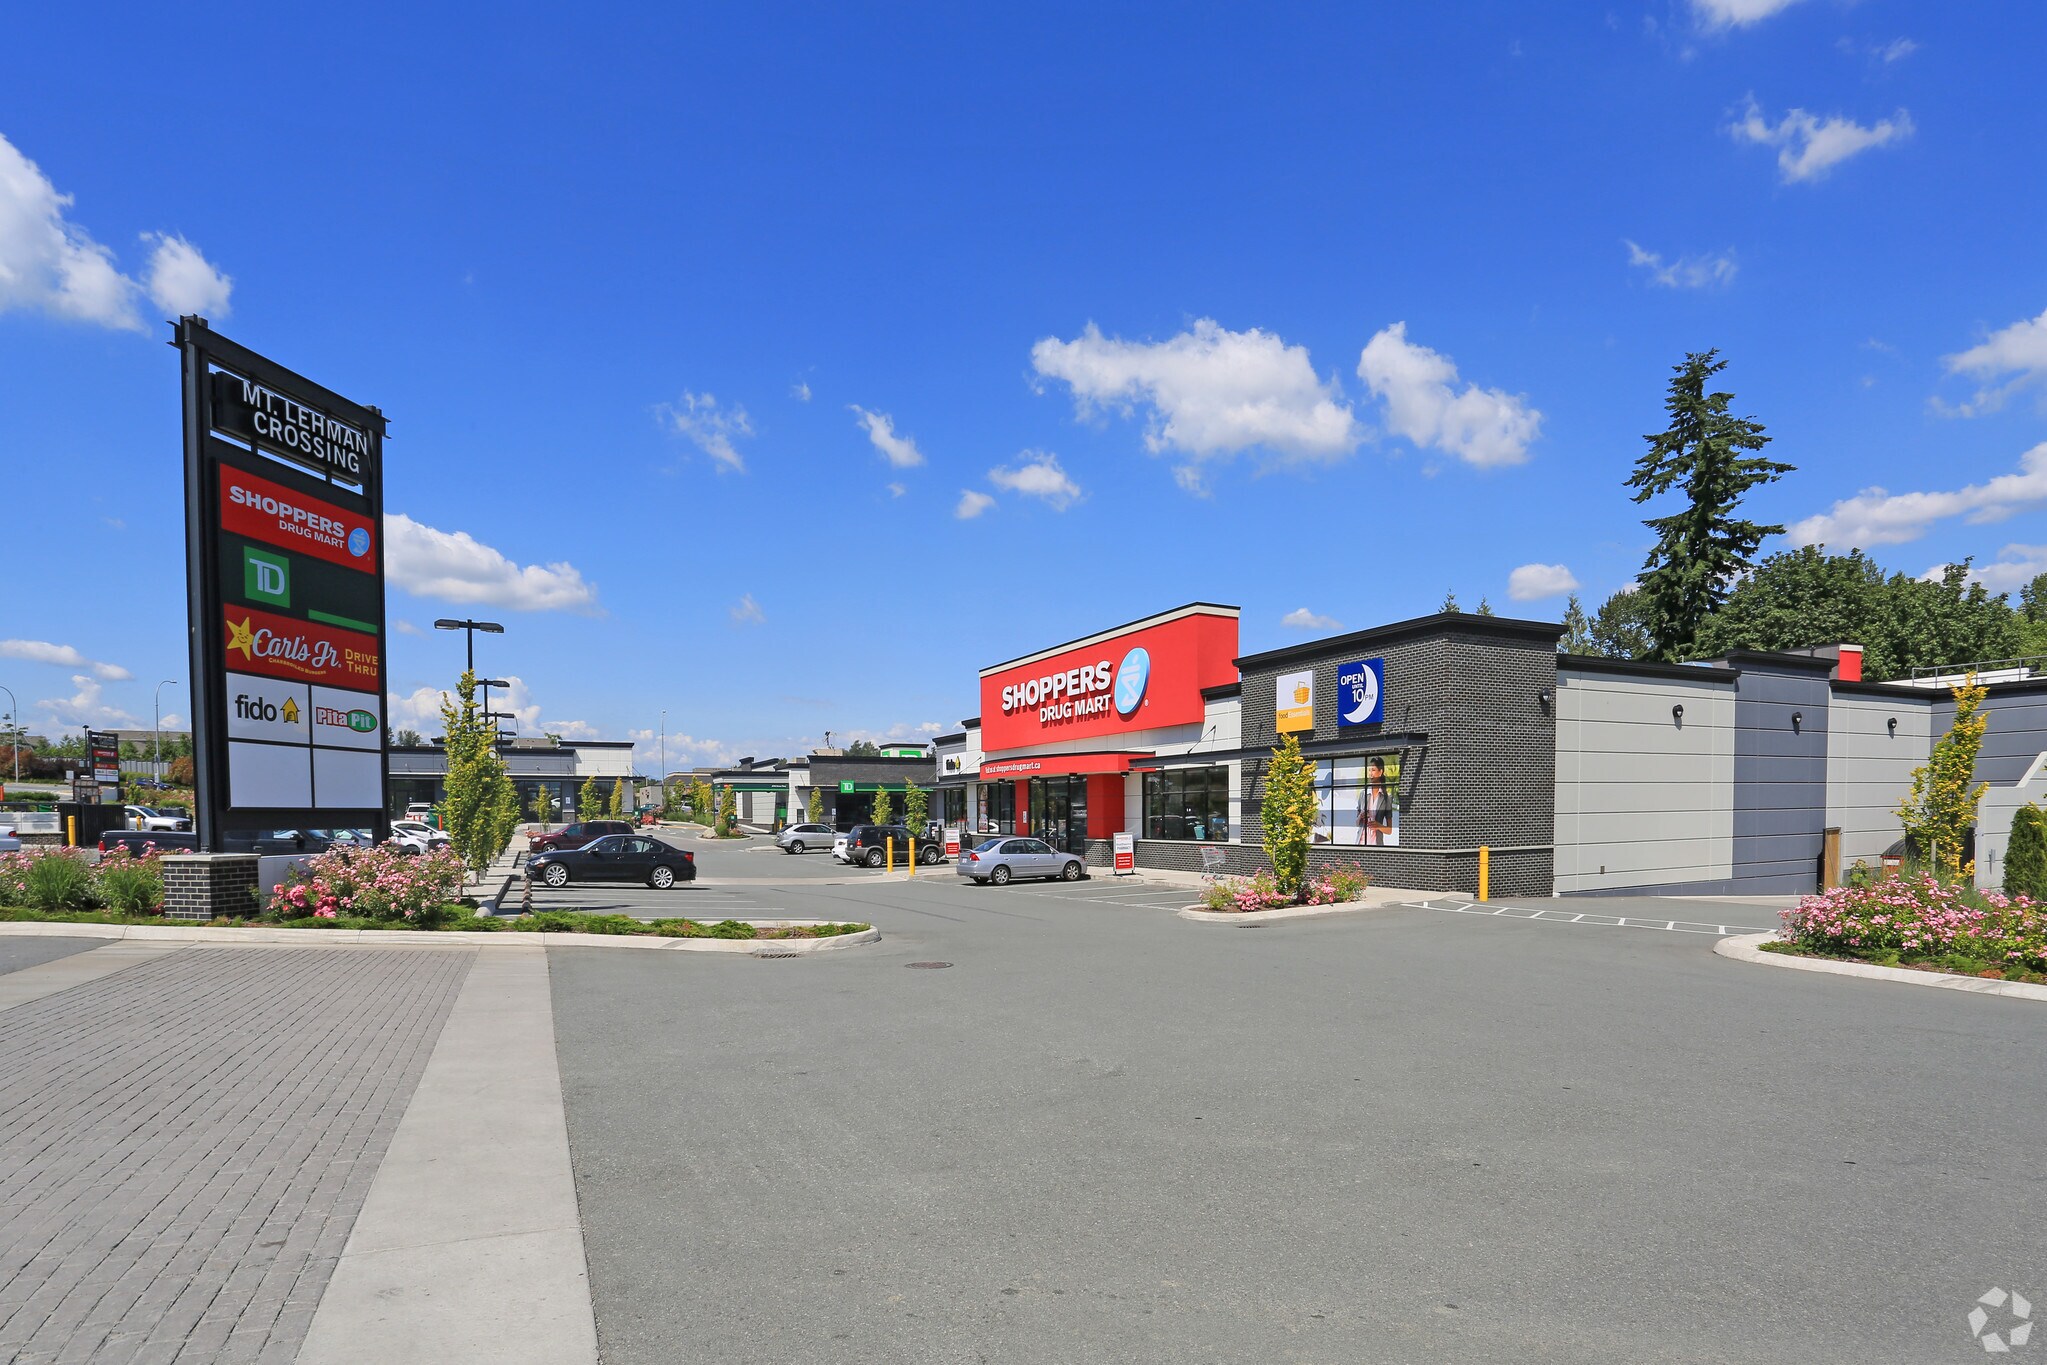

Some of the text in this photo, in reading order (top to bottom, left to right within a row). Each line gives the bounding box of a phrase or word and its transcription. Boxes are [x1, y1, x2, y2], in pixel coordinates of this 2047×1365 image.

[243, 381, 367, 455] MT. LEHMAN
[254, 411, 359, 473] CROSSING
[229, 485, 345, 538] SHOPPERS
[279, 519, 345, 549] DRUG MART
[249, 558, 285, 595] TD
[252, 628, 311, 662] Carl's
[345, 648, 378, 666] DRIVE
[346, 661, 378, 677] THRU
[1340, 672, 1365, 686] OPEN
[1002, 660, 1112, 711] SHOPPERS
[1352, 688, 1374, 703] 10 PM
[235, 694, 277, 722] fido
[317, 708, 372, 729] Pita Pit
[1039, 694, 1112, 723] DRUG MART
[842, 782, 853, 791] TD
